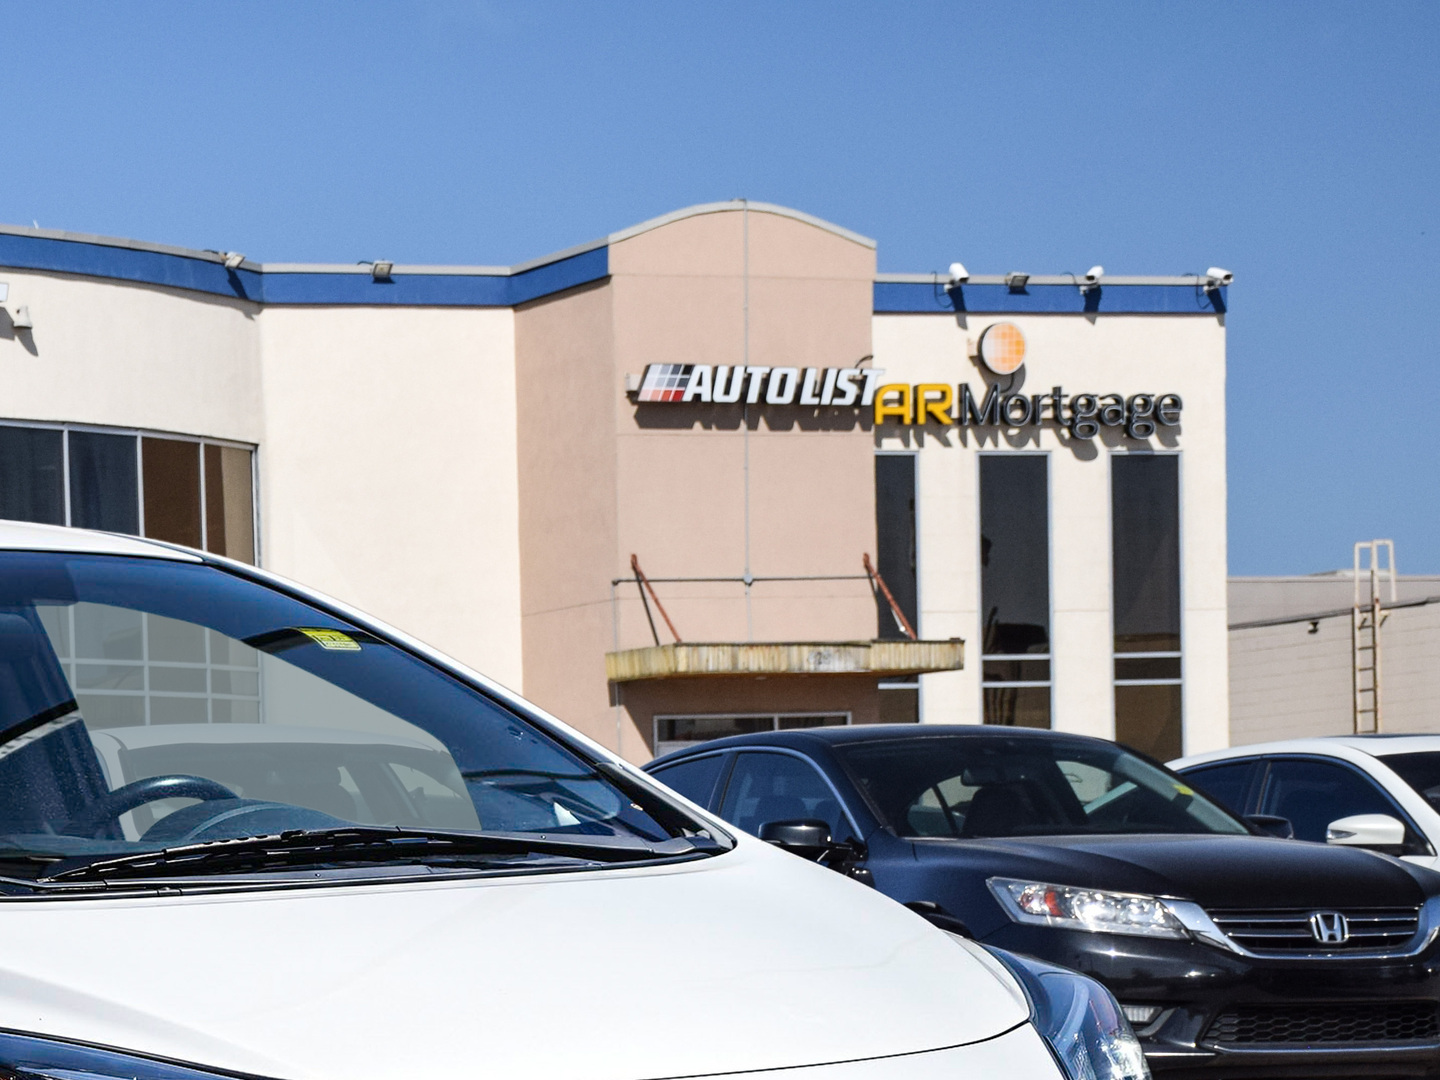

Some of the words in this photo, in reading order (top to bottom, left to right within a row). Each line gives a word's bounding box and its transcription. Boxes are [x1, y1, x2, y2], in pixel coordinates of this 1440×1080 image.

[684, 364, 798, 405] AUTO
[799, 367, 886, 406] LIST
[962, 382, 1184, 440] Mortgage
